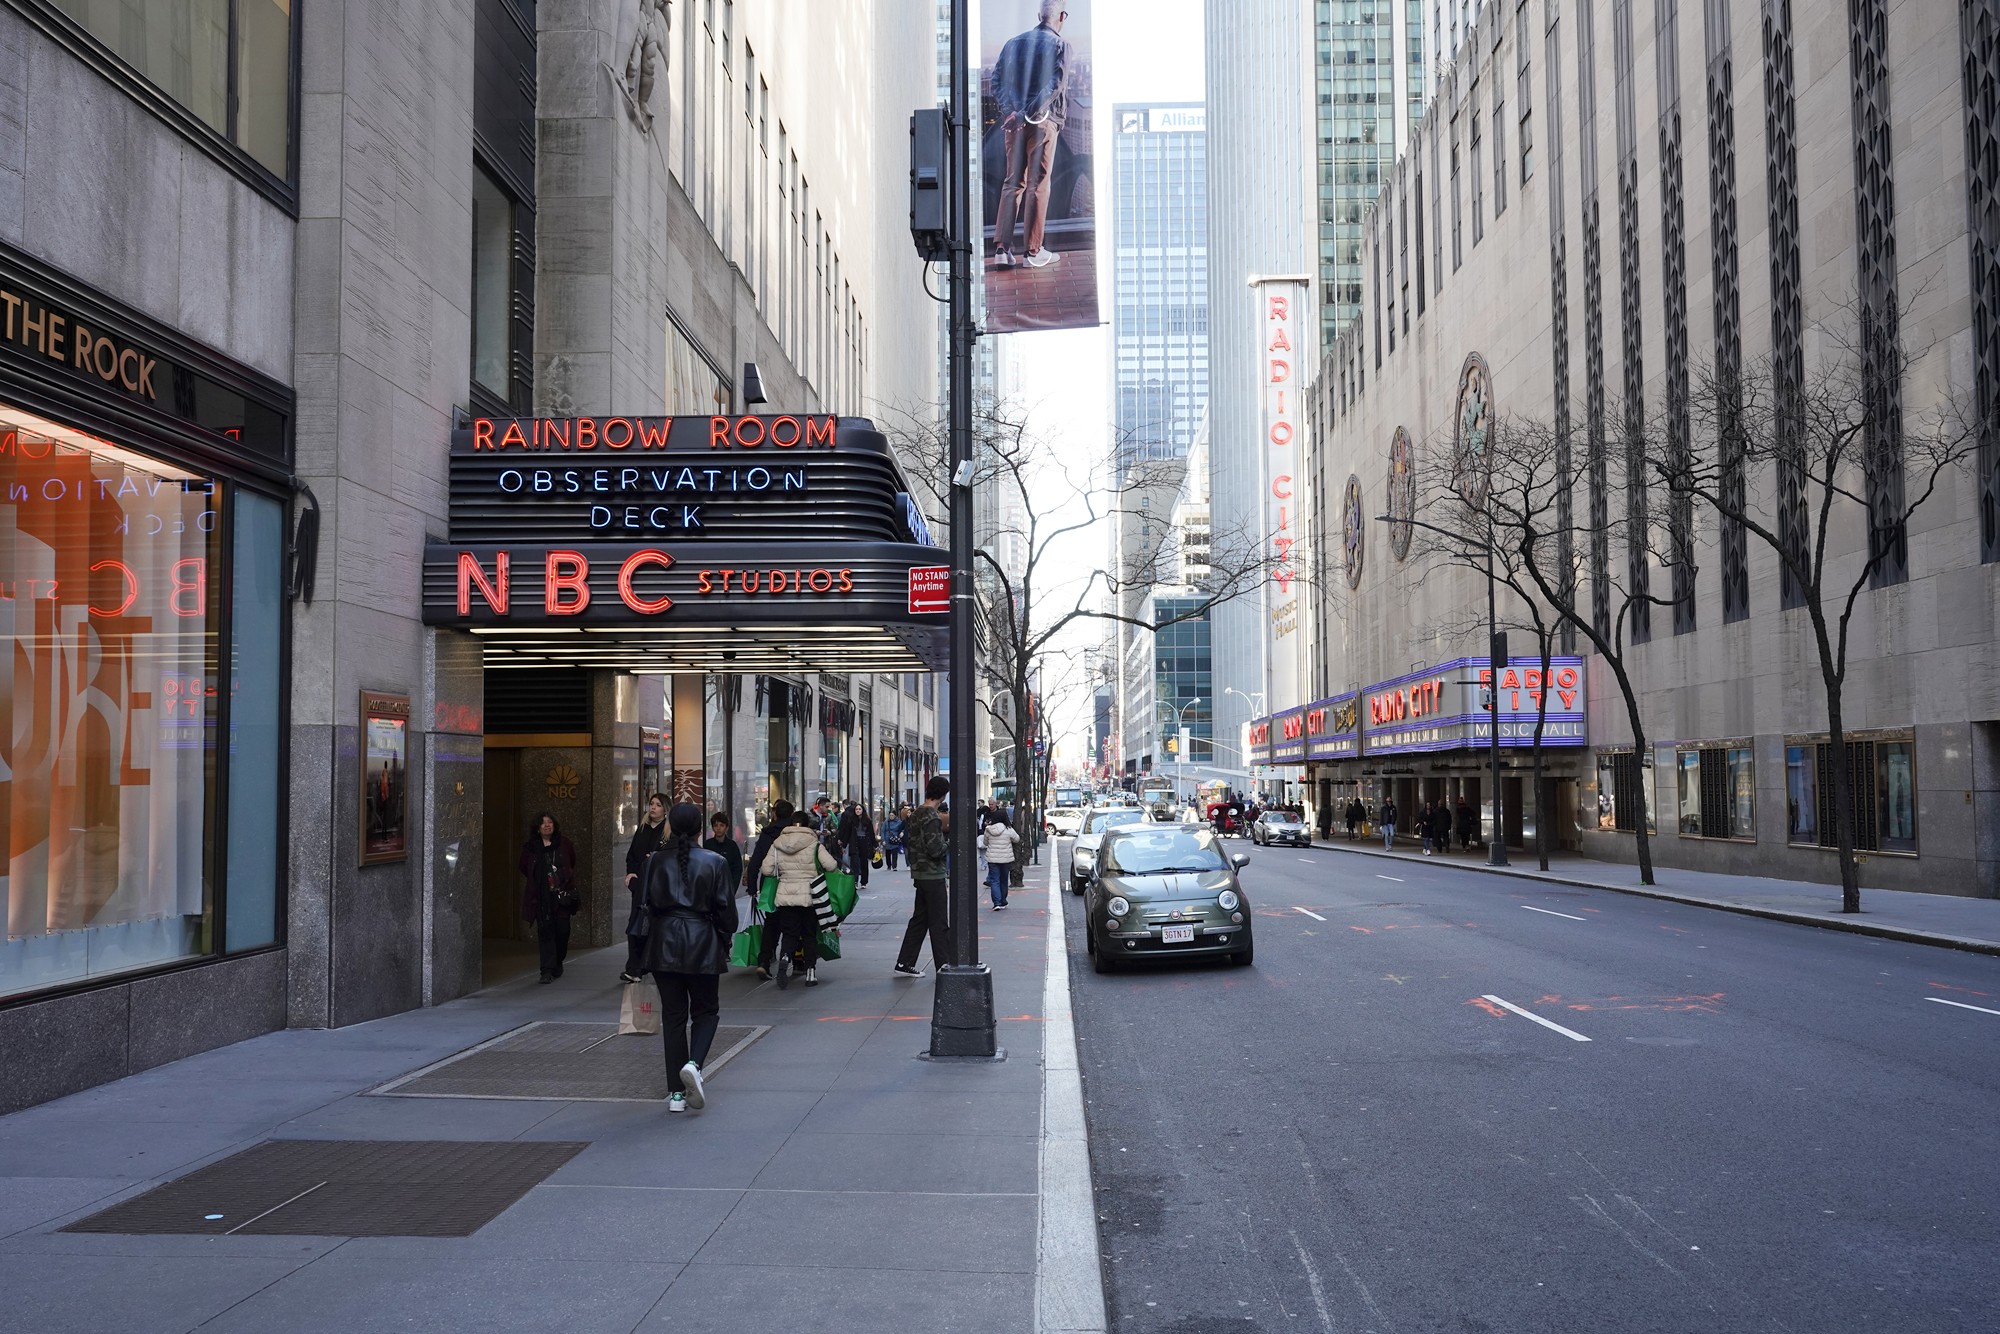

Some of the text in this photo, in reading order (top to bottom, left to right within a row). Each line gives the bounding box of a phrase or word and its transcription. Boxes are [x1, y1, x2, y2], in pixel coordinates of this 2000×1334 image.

[0, 289, 156, 400] THE ROCK
[473, 415, 837, 451] RAINBOW ROOM
[1269, 296, 1296, 593] RADIO CITY
[499, 467, 806, 492] OBSERVATION
[591, 504, 702, 529] DECK
[457, 549, 854, 617] NBC STUDIOS
[913, 572, 923, 581] NO
[913, 582, 944, 592] Anytime
[1271, 600, 1297, 625] MUSIC
[1275, 617, 1297, 640] HALL
[1371, 689, 1405, 726] RADIO
[1410, 677, 1441, 717] CITY
[1480, 690, 1577, 711] ITY
[1308, 707, 1326, 736] CITY
[1475, 723, 1529, 737] MSIC
[549, 786, 577, 799] NBC
[1183, 929, 1192, 938] 17
